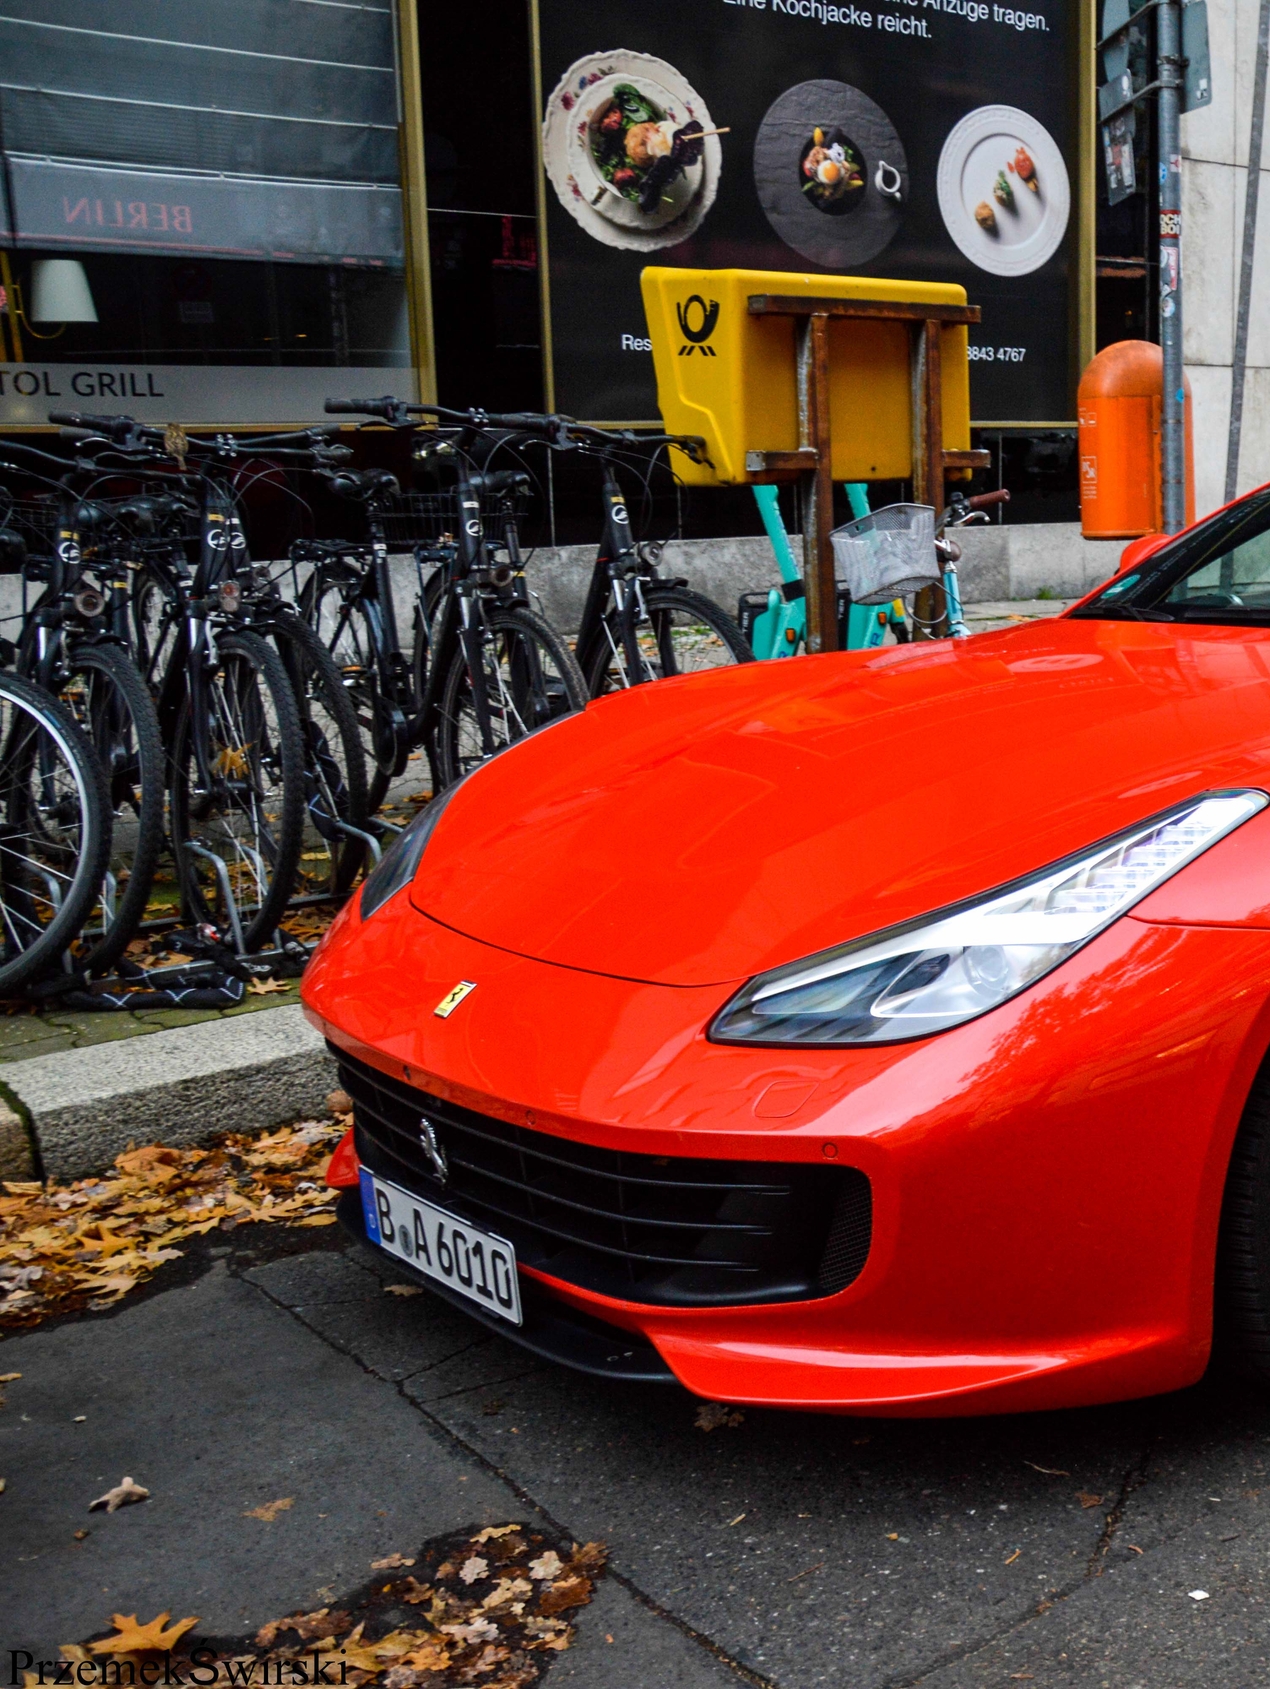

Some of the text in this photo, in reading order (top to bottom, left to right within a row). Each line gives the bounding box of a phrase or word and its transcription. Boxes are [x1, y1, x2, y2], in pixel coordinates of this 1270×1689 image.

[877, 13, 933, 38] reicht.
[993, 4, 1051, 31] tragen.
[621, 334, 652, 351] Res
[996, 347, 1027, 362] 4767
[71, 371, 165, 397] GRILL
[375, 1187, 396, 1244] B
